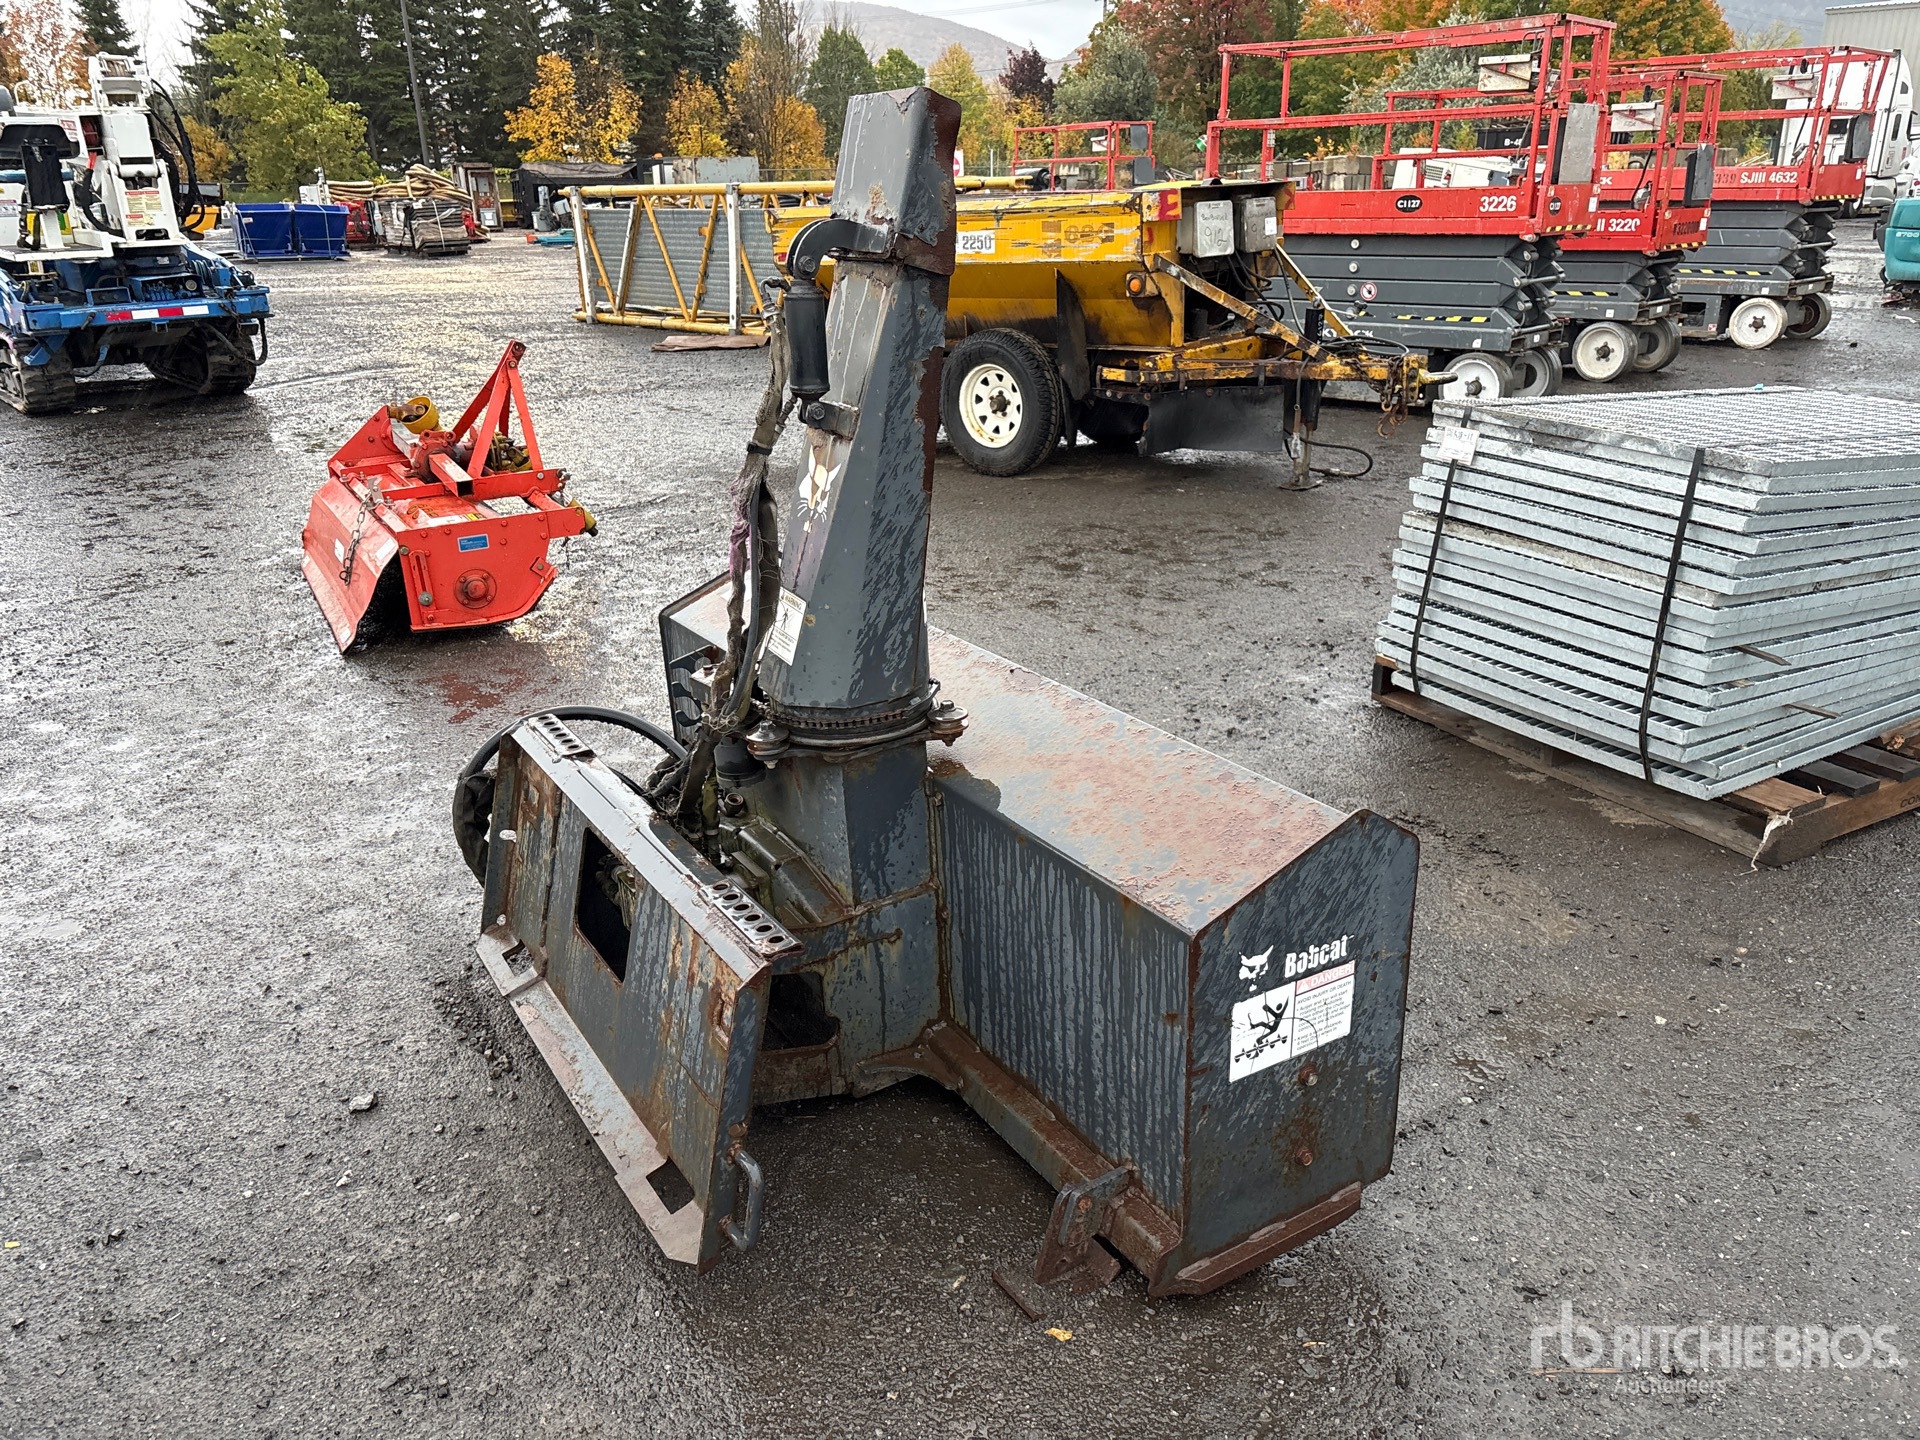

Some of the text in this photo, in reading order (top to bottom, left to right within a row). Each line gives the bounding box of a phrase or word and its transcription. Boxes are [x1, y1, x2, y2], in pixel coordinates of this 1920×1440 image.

[1768, 171, 1798, 184] 4632
[1479, 195, 1517, 213] 3226
[962, 234, 992, 251] 2250
[1284, 934, 1355, 979] Bobcat
[1311, 965, 1353, 986] DANGER
